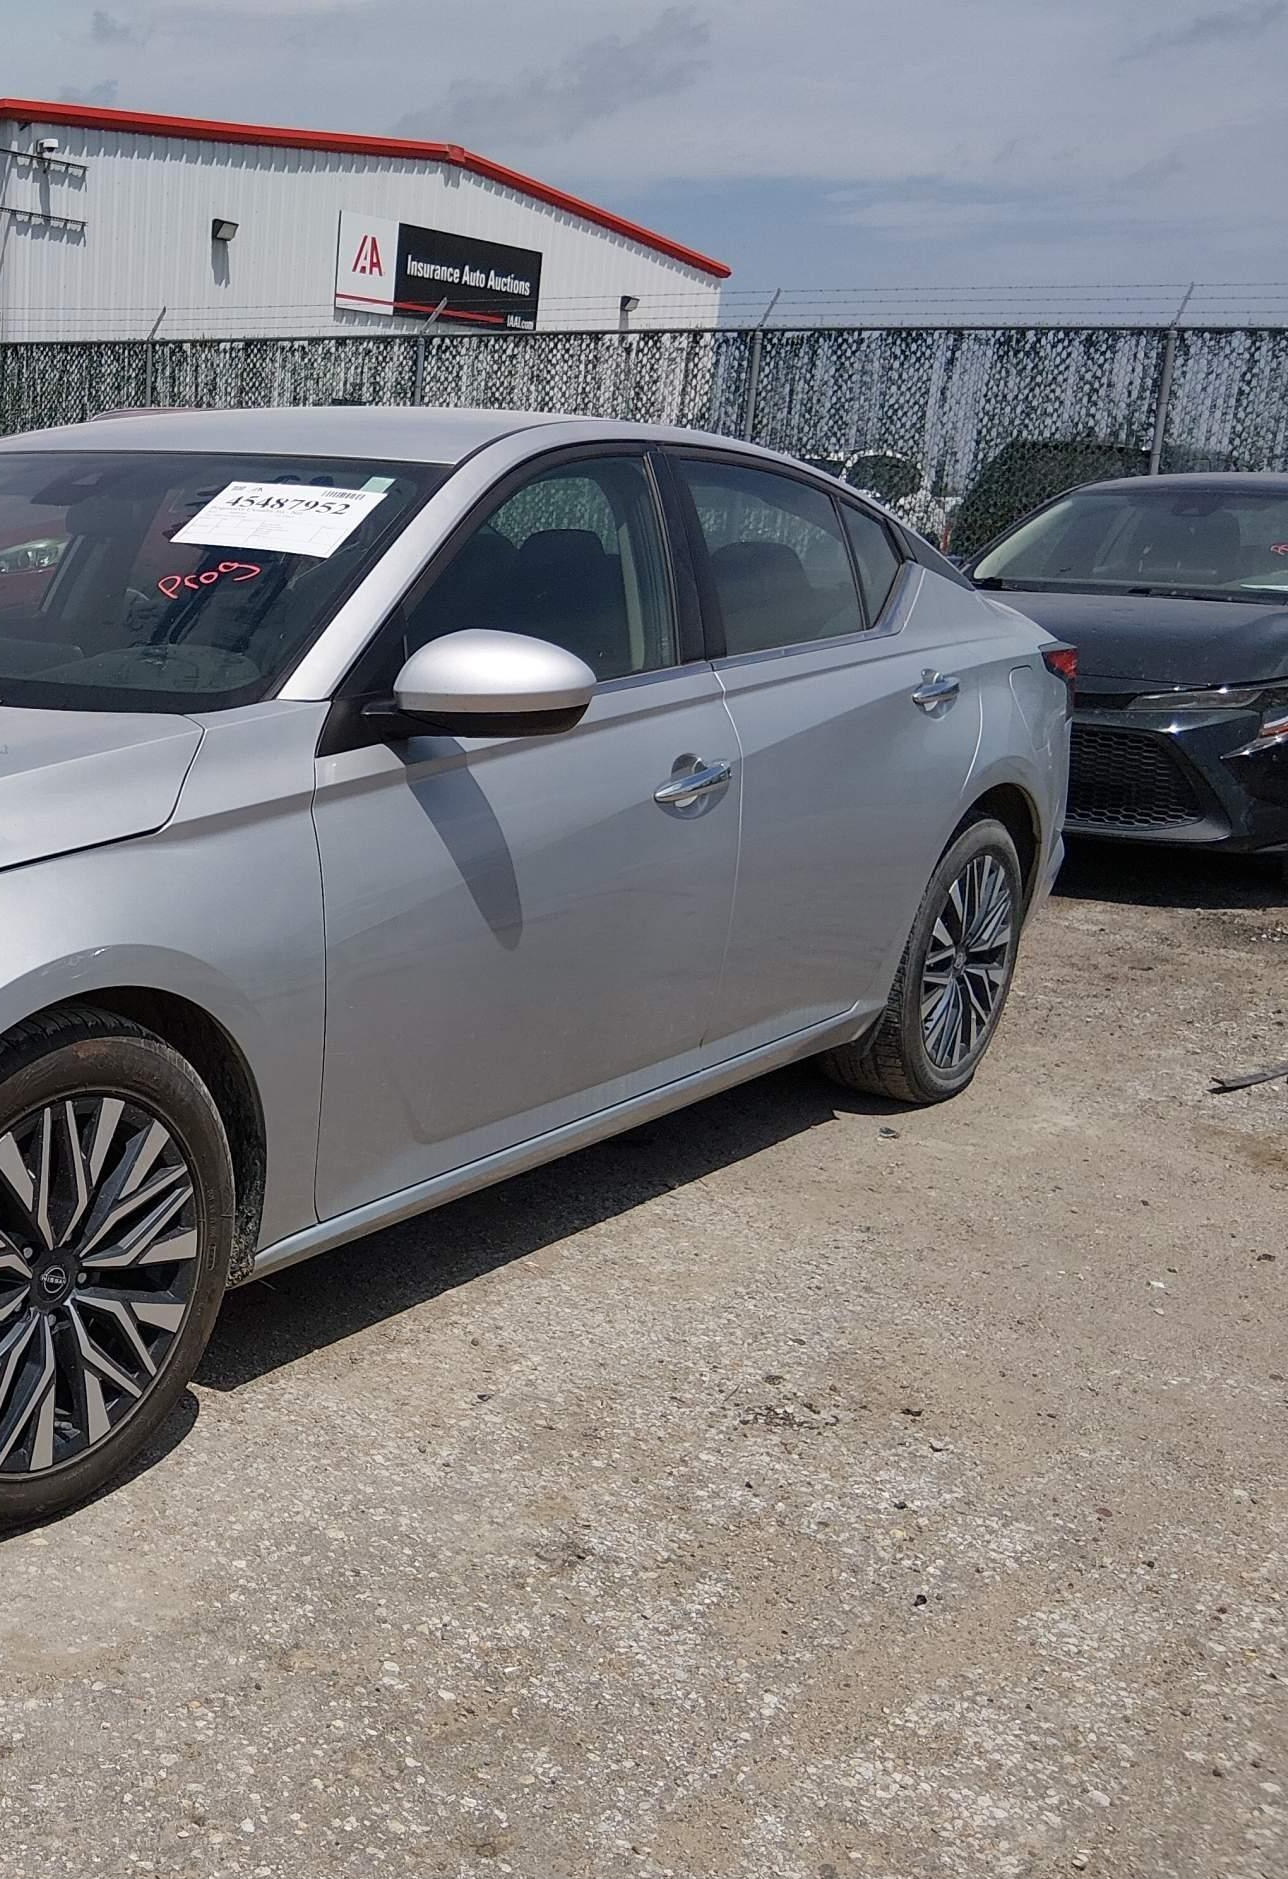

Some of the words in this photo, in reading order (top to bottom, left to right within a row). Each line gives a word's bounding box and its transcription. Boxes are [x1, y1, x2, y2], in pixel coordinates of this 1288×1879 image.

[406, 254, 460, 284] Insurance
[461, 265, 486, 288] Auto
[487, 269, 531, 296] Auctions
[225, 495, 351, 515] 45487952
[40, 1273, 67, 1285] NISSAN
